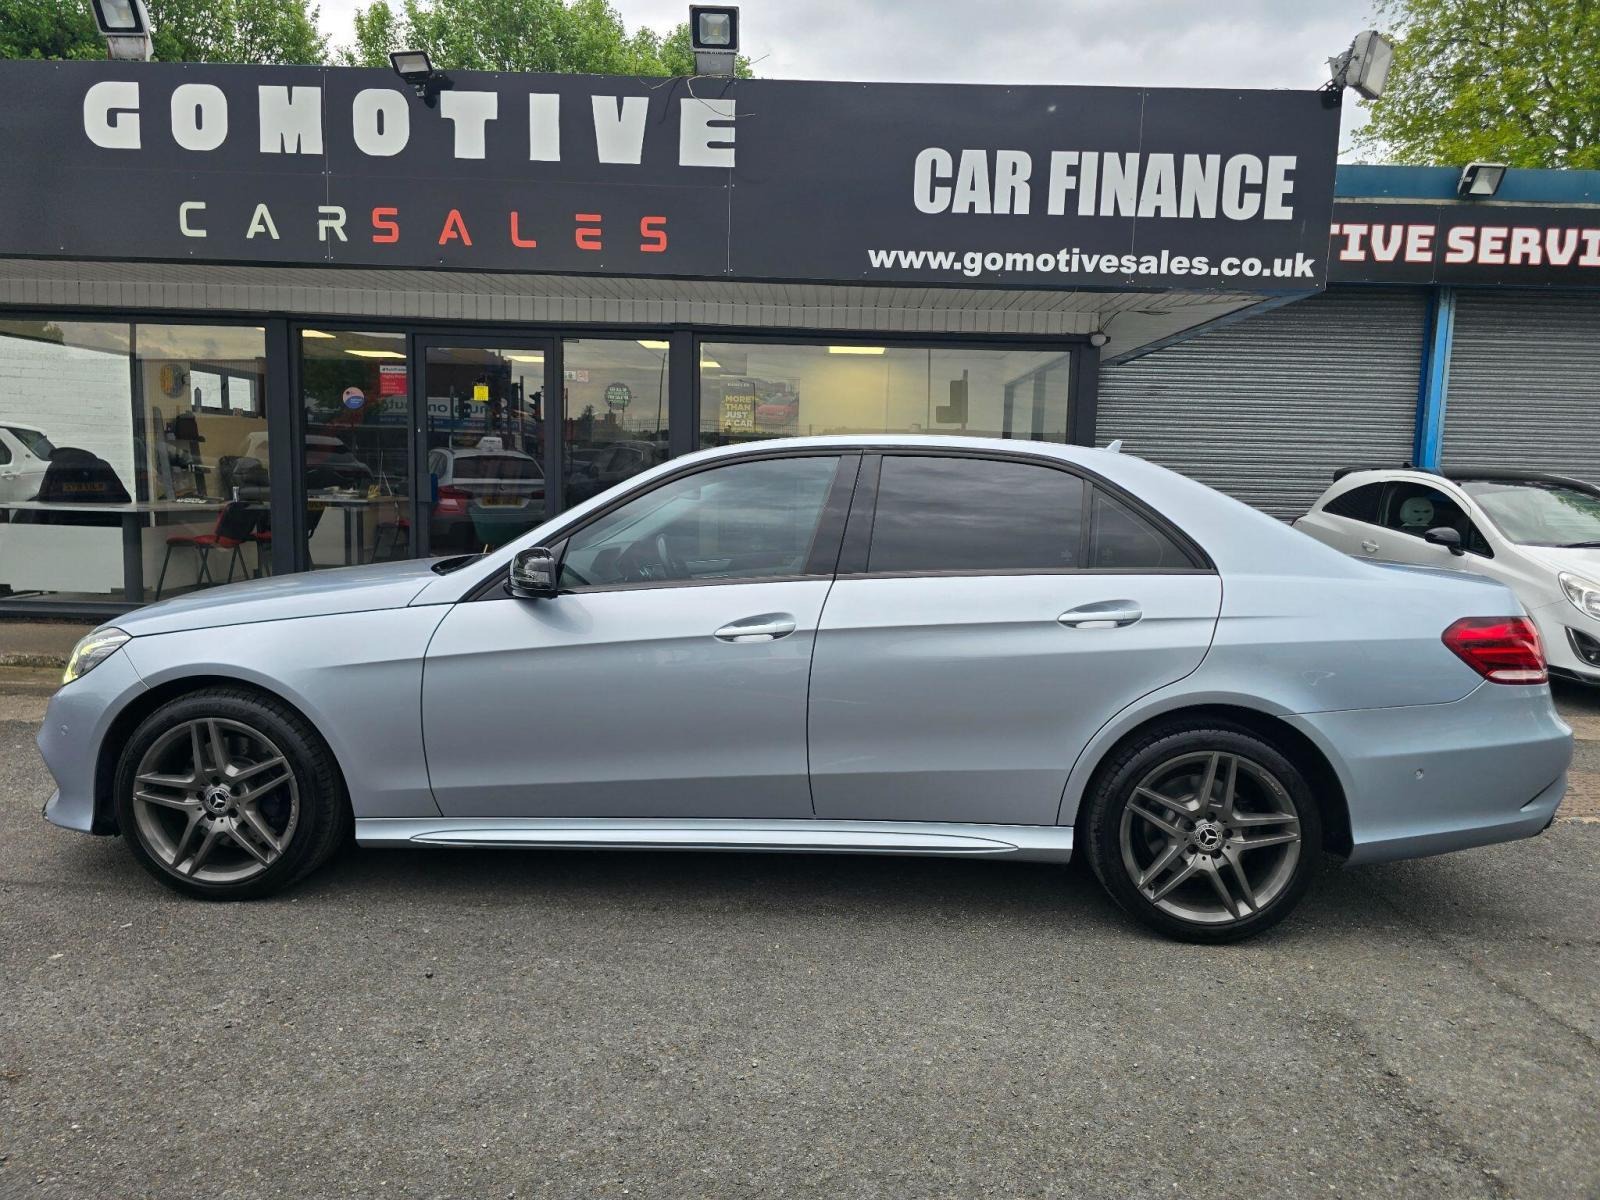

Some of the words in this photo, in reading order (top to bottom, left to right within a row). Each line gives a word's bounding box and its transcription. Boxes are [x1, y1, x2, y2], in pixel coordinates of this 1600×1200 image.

[83, 80, 737, 168] GOMOTIVE
[913, 147, 1033, 215] CAR
[1047, 151, 1298, 221] FINANCE
[1329, 222, 1437, 263] IVE
[1444, 225, 1600, 267] SERVI
[867, 247, 1316, 279] www.gomotivesales.co.uk
[725, 395, 752, 403] MORE
[725, 403, 751, 411] THAN
[725, 411, 748, 419] JUST
